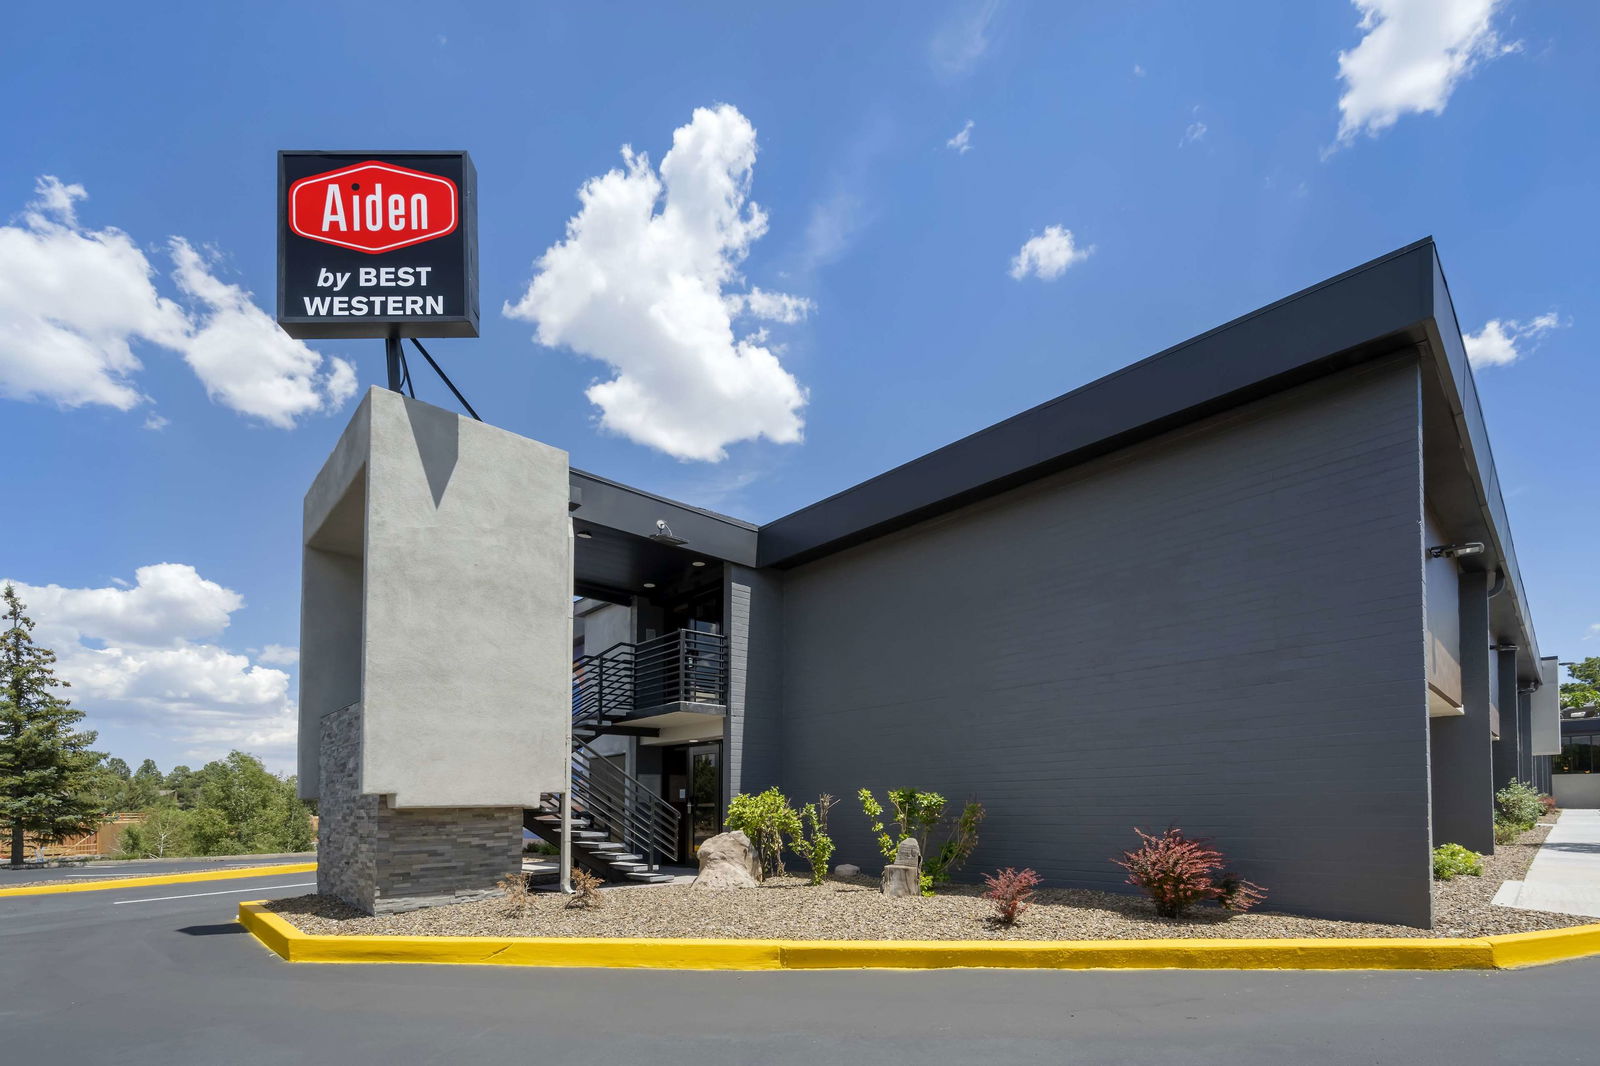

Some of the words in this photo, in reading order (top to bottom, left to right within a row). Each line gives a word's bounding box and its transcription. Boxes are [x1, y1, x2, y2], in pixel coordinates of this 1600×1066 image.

[321, 183, 428, 232] Aiden
[316, 267, 352, 292] by
[359, 266, 432, 287] BEST
[303, 295, 444, 316] WESTERN
